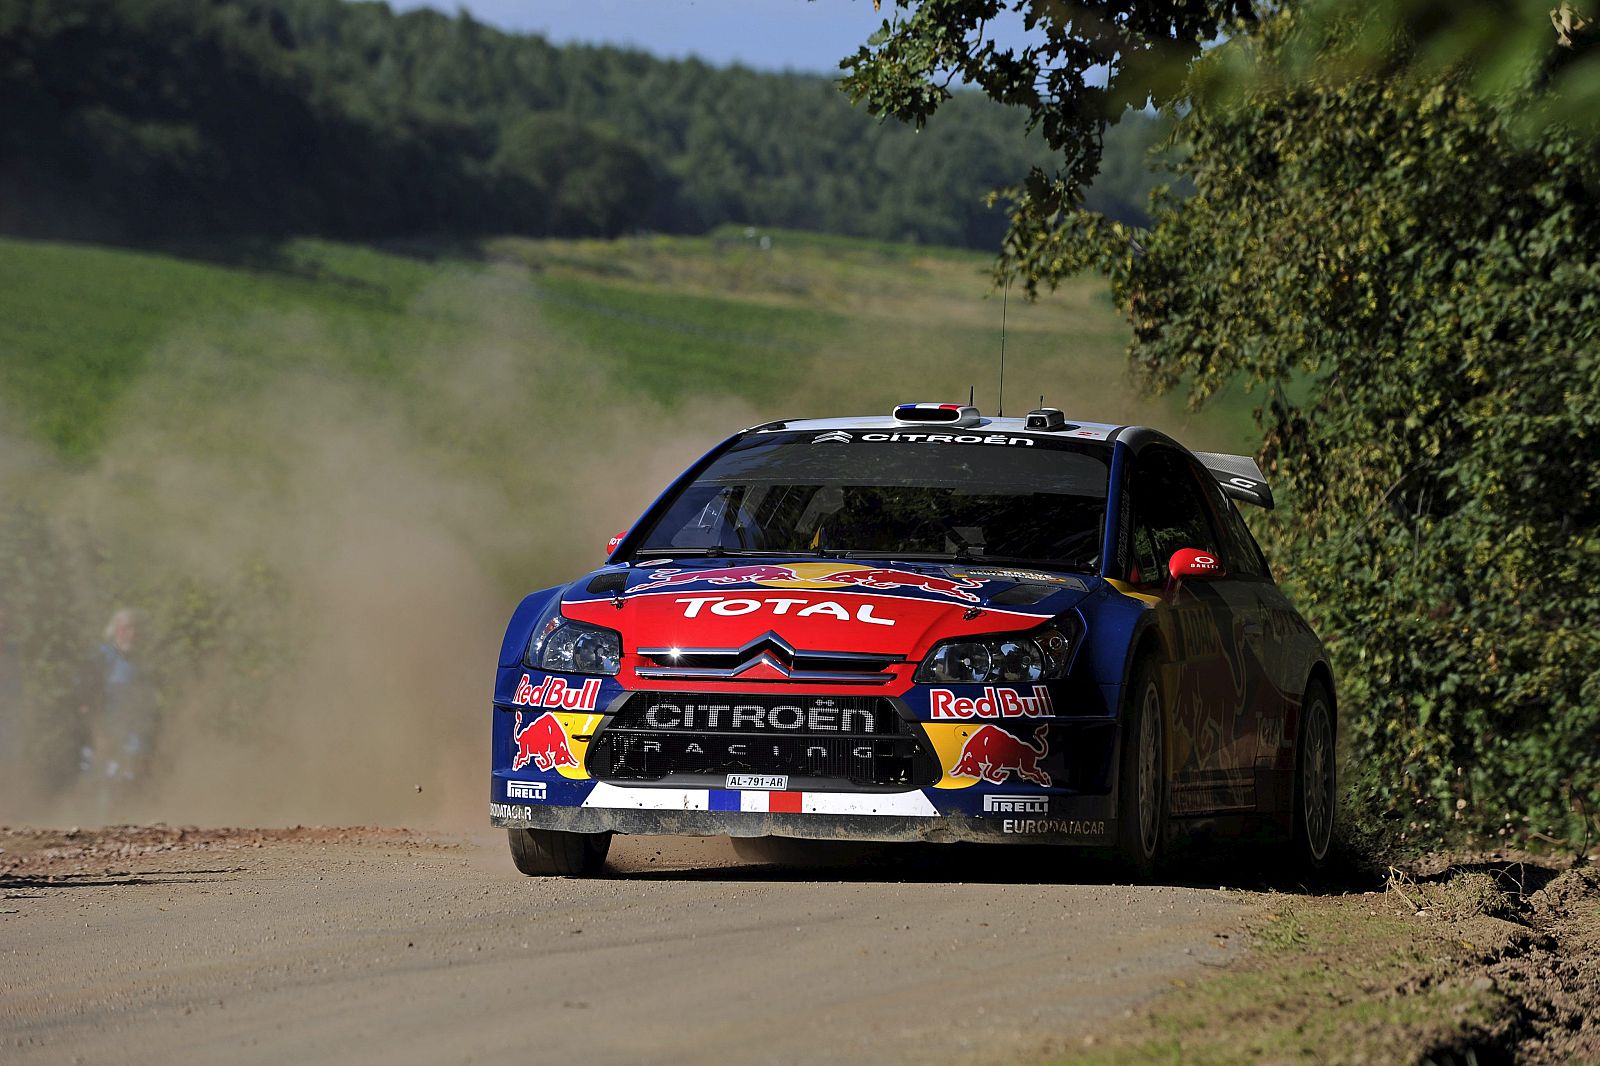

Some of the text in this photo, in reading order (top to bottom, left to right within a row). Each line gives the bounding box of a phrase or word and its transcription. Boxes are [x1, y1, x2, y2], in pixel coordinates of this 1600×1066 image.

[675, 596, 896, 626] TOTAL
[512, 674, 602, 710] Red Bull
[930, 685, 1056, 719] Red Bull
[506, 780, 547, 800] PIRELLI
[730, 776, 783, 787] AL-791-AR
[983, 794, 1049, 812] PIRELLI
